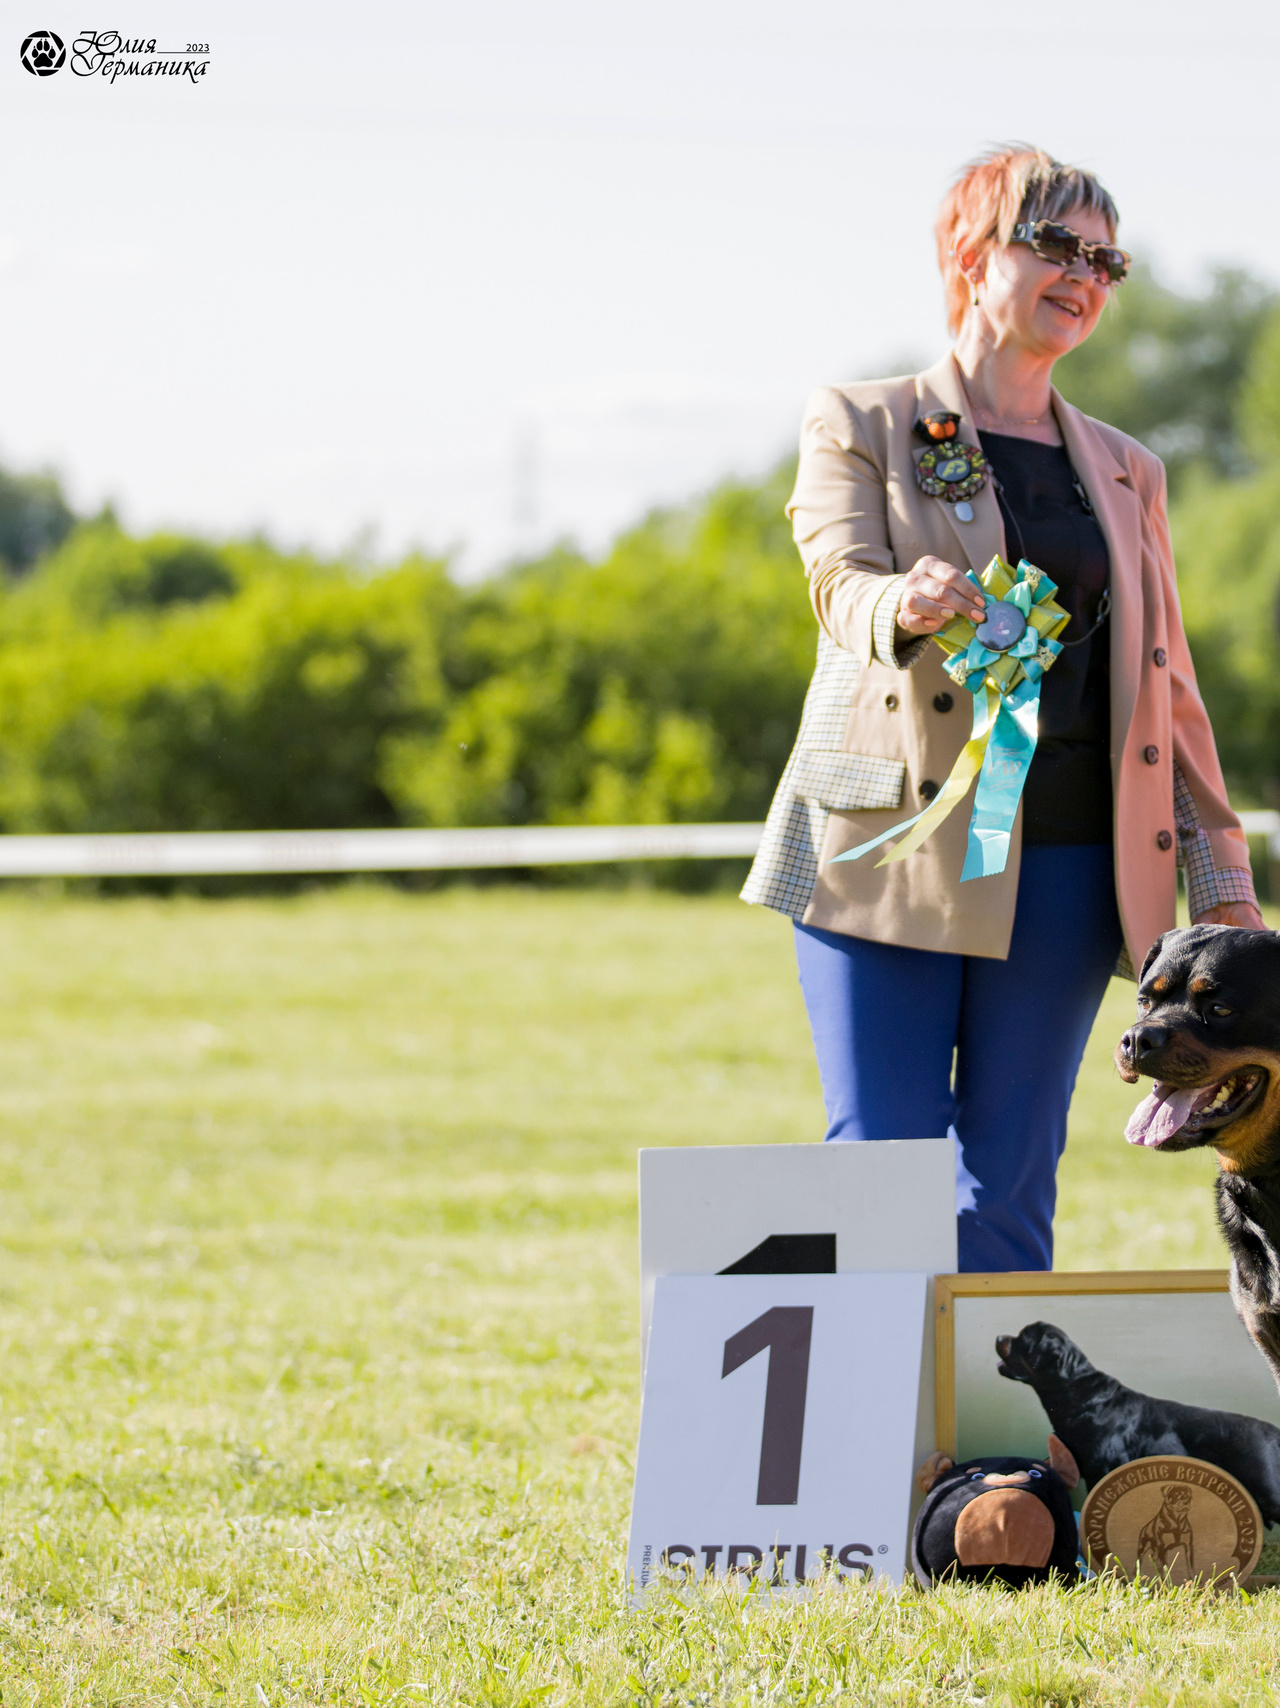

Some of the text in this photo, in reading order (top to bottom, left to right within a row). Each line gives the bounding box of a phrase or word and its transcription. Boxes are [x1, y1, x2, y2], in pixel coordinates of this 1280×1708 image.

[721, 1306, 814, 1505] 1
[1175, 1465, 1247, 1514] ВСТРЕЧИ
[1239, 1517, 1255, 1554] 2023
